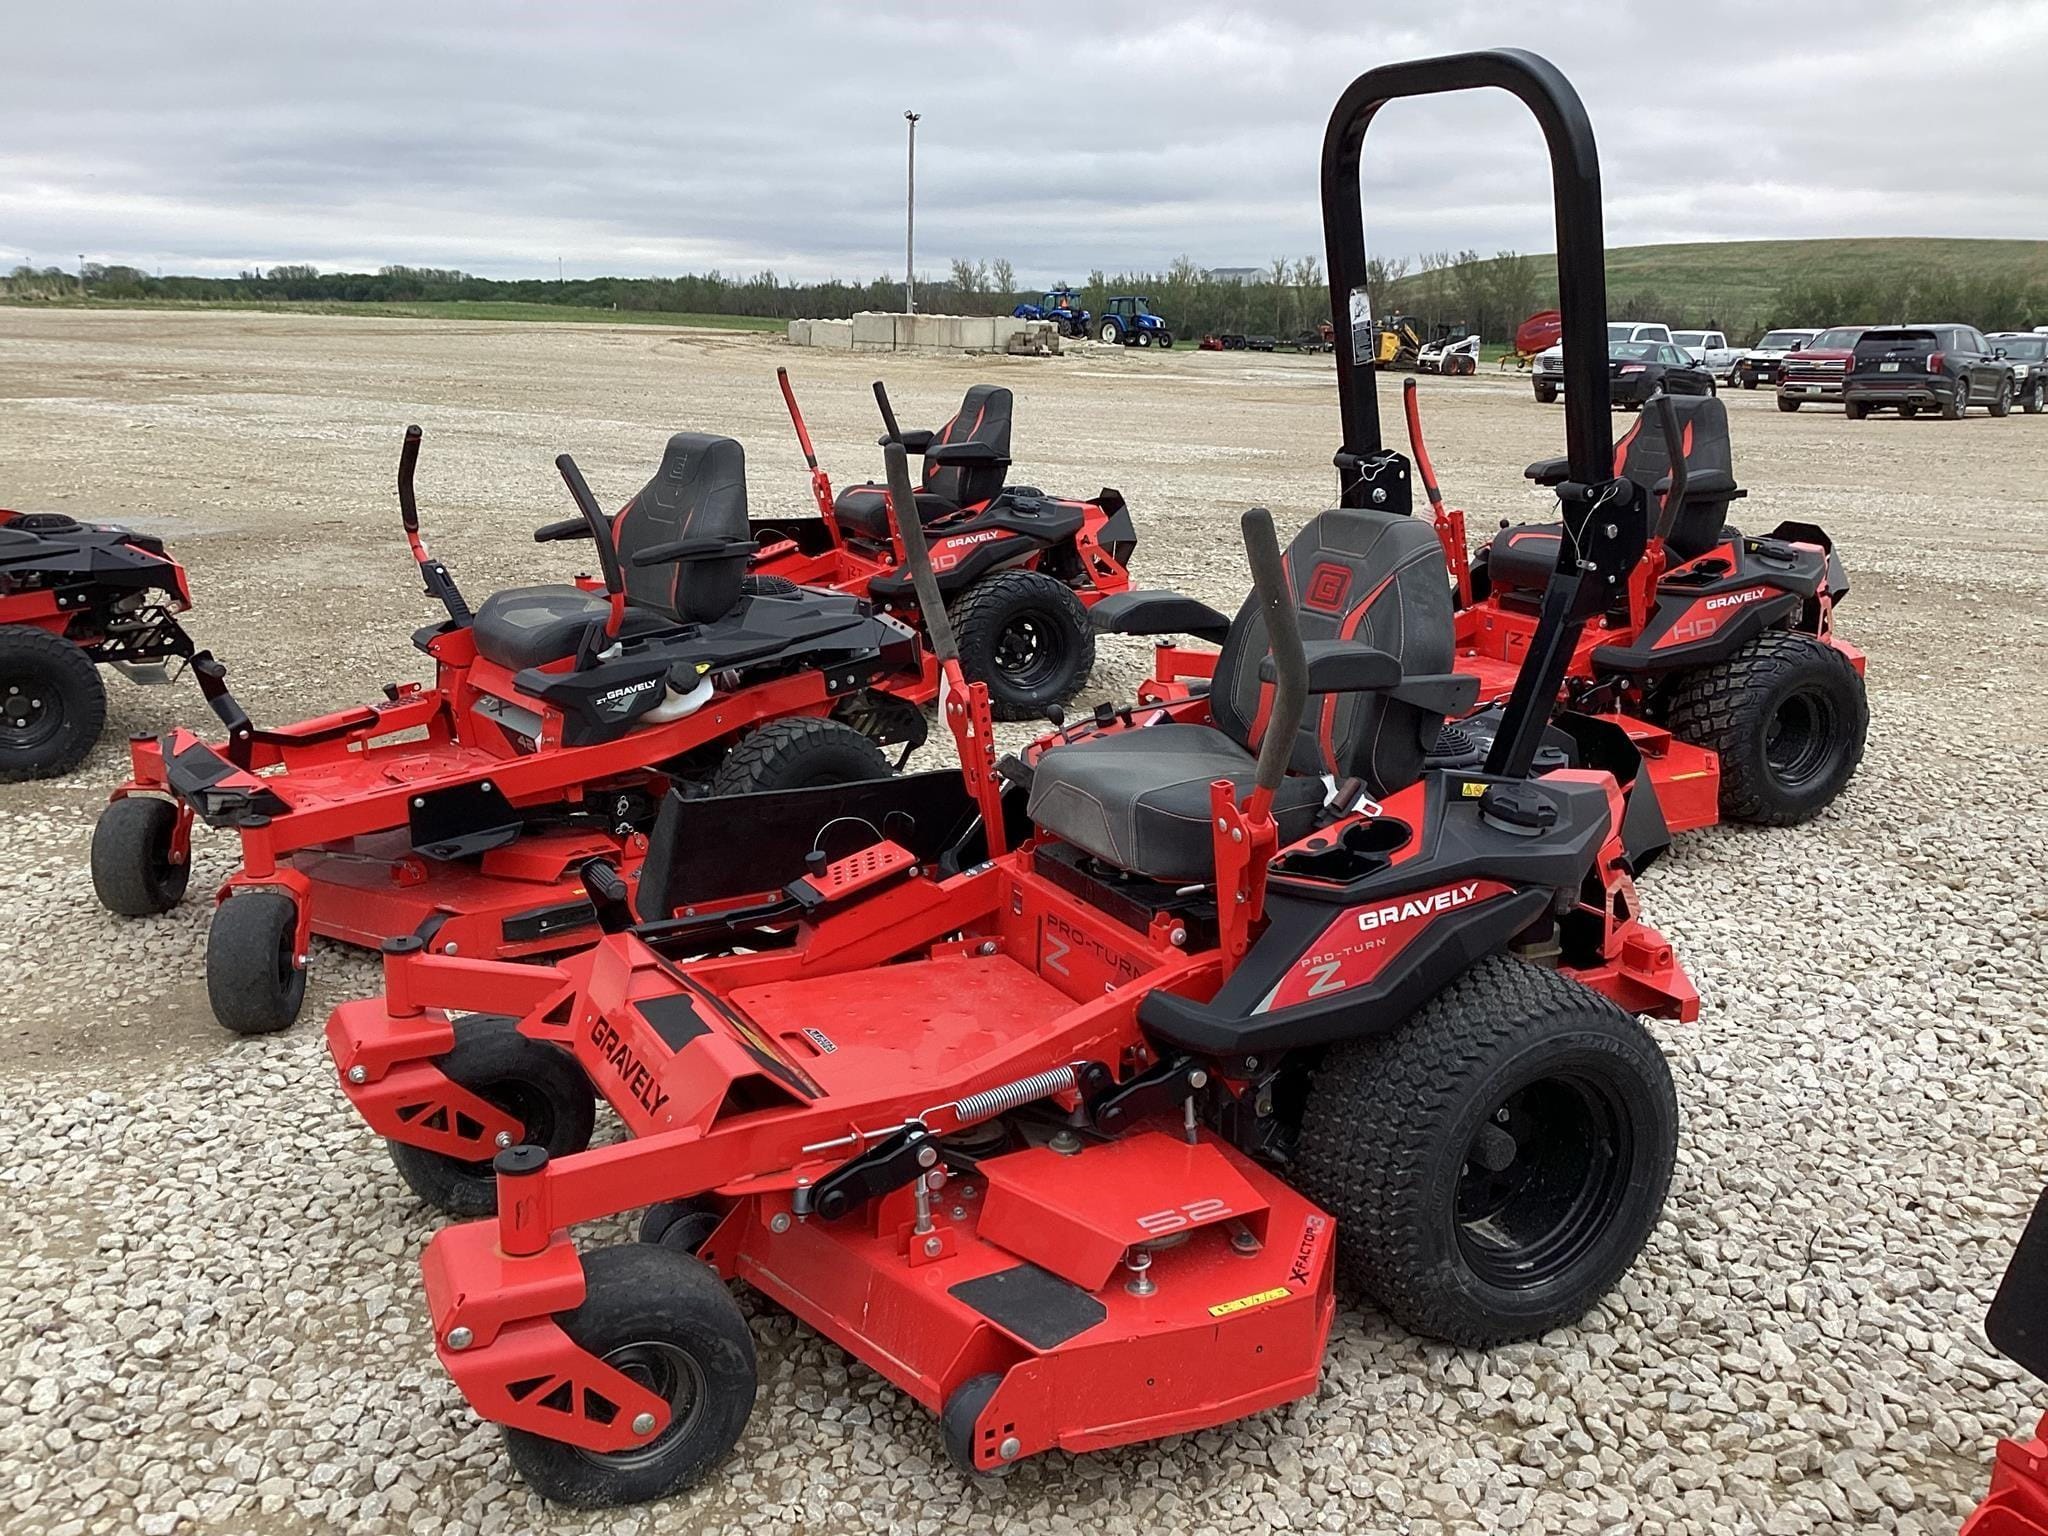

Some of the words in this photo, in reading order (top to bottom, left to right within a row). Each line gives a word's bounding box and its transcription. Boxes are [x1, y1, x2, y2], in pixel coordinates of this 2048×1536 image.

[947, 530, 999, 549] GRAVELY
[1706, 588, 1766, 610] GRAVELY
[1672, 617, 1717, 640] HD
[606, 679, 657, 700] GRAVELY
[1358, 882, 1479, 931] GRAVELY
[1046, 933, 1070, 976] Z
[1301, 937, 1387, 968] PRO-TURN
[1305, 960, 1346, 997] Z
[590, 1015, 670, 1117] GRAVELY
[1136, 1198, 1232, 1234] 52
